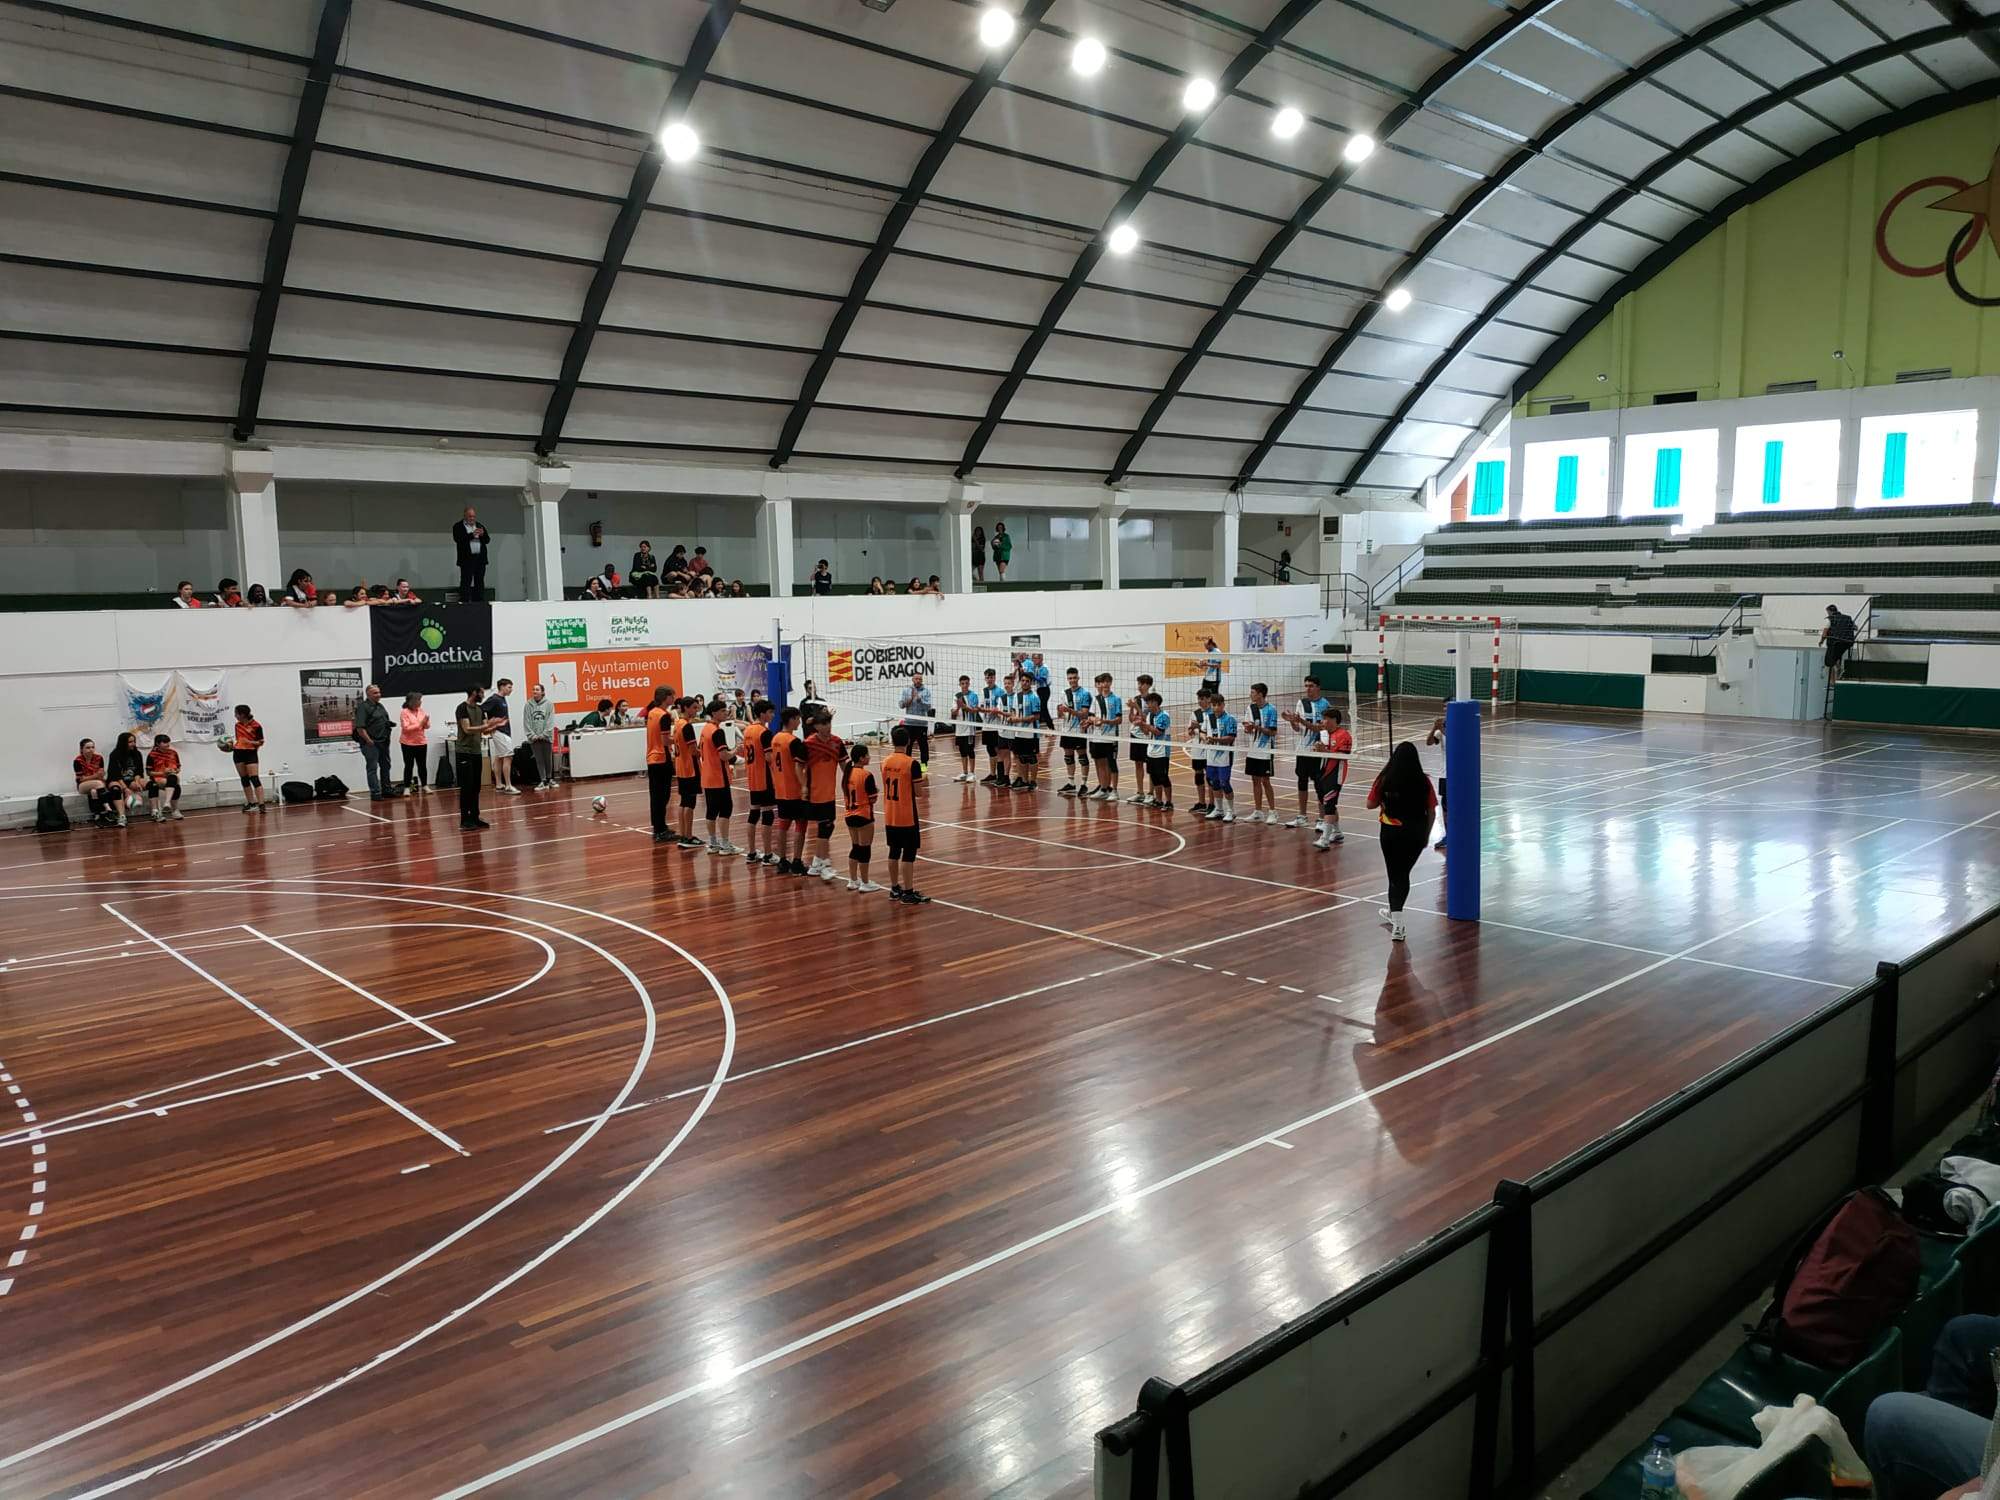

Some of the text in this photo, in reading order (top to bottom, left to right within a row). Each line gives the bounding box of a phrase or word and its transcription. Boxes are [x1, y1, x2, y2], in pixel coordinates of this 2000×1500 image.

[624, 616, 648, 625] HUESCA
[384, 646, 483, 674] podoactiva
[854, 646, 925, 664] GOBIERNO
[582, 659, 669, 677] Ayuntamiento
[855, 660, 935, 681] DE ARAGON
[308, 678, 330, 686] CIUDAD
[340, 679, 361, 687] HUESCA
[582, 677, 650, 691] de Huesca
[885, 777, 900, 802] 11
